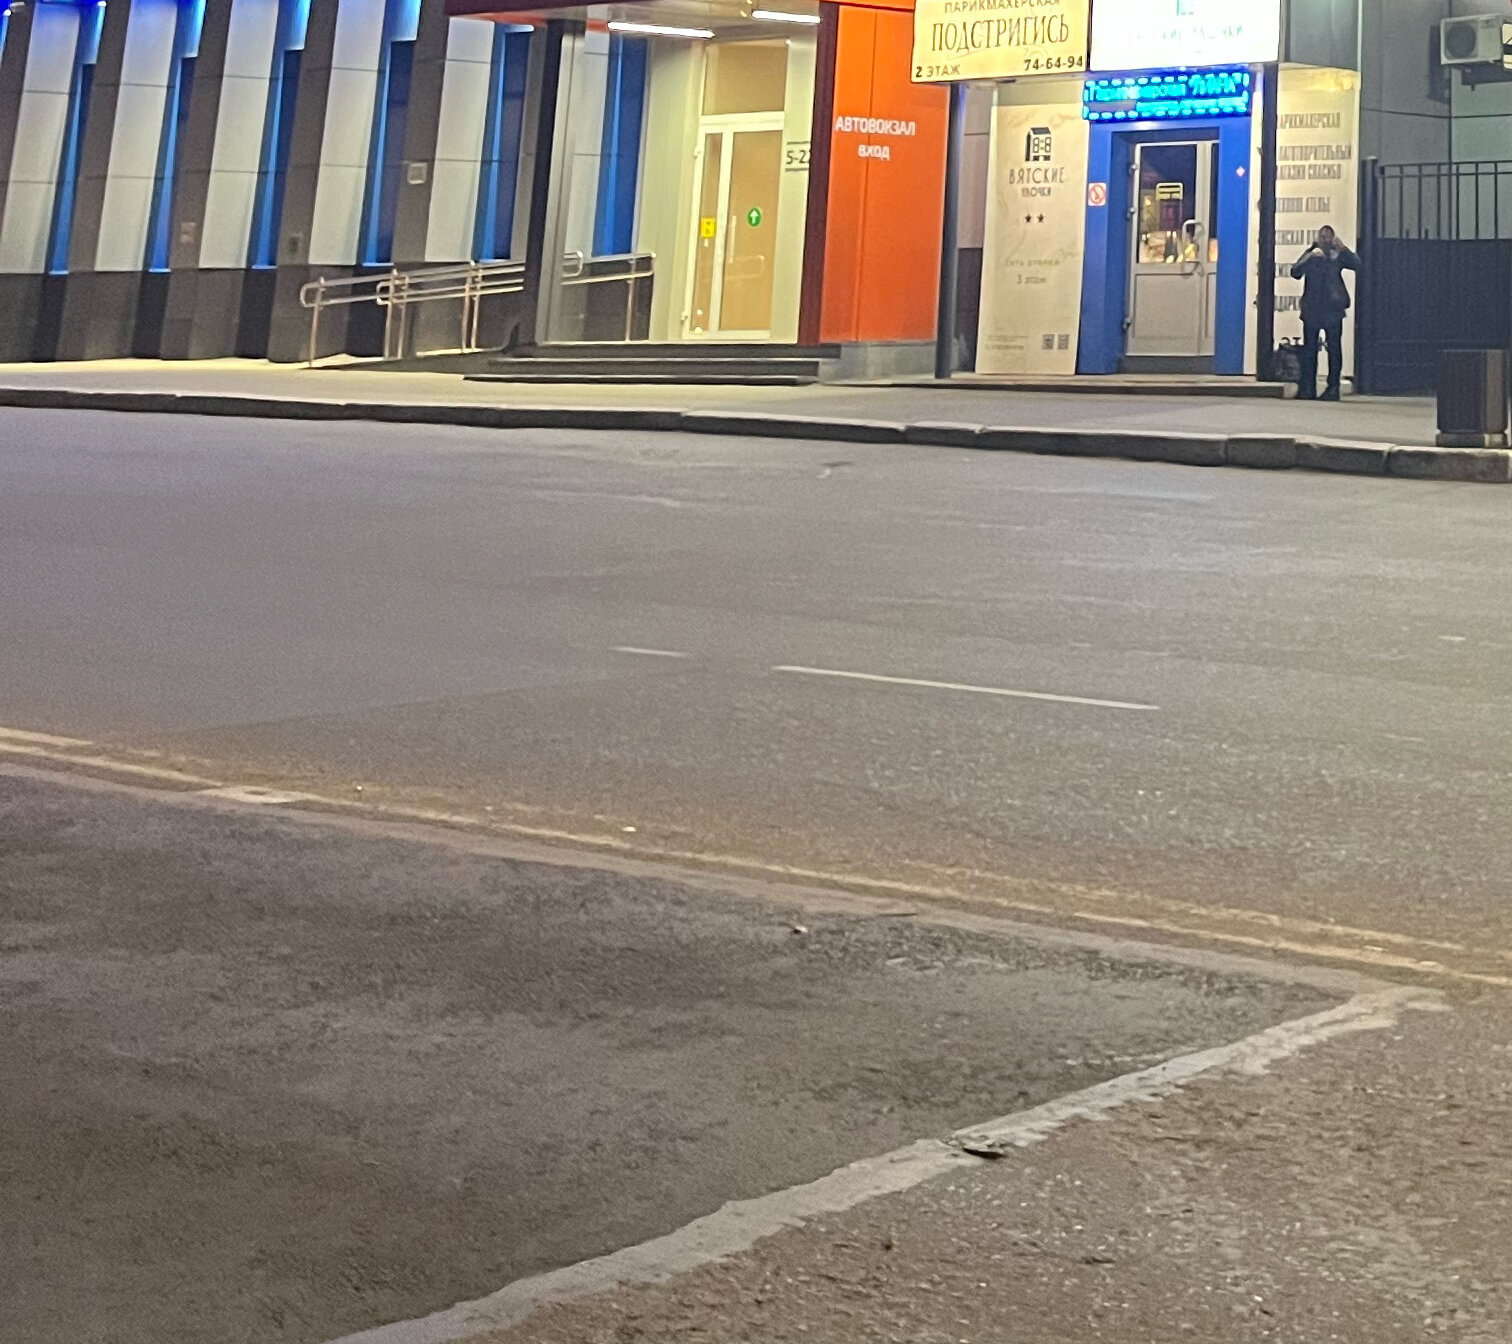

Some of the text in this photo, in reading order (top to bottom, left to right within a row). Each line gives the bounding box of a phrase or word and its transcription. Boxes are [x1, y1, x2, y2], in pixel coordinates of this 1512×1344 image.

[931, 13, 1070, 53] ПОДСТРИГИСЬ
[915, 64, 961, 78] 2 ЭТАЖ
[1024, 55, 1084, 71] 74-64-94
[835, 116, 917, 136] АВТОВОКЗАЛ
[857, 144, 891, 161] ВХОД
[1008, 167, 1065, 185] ВЯТСКИЕ
